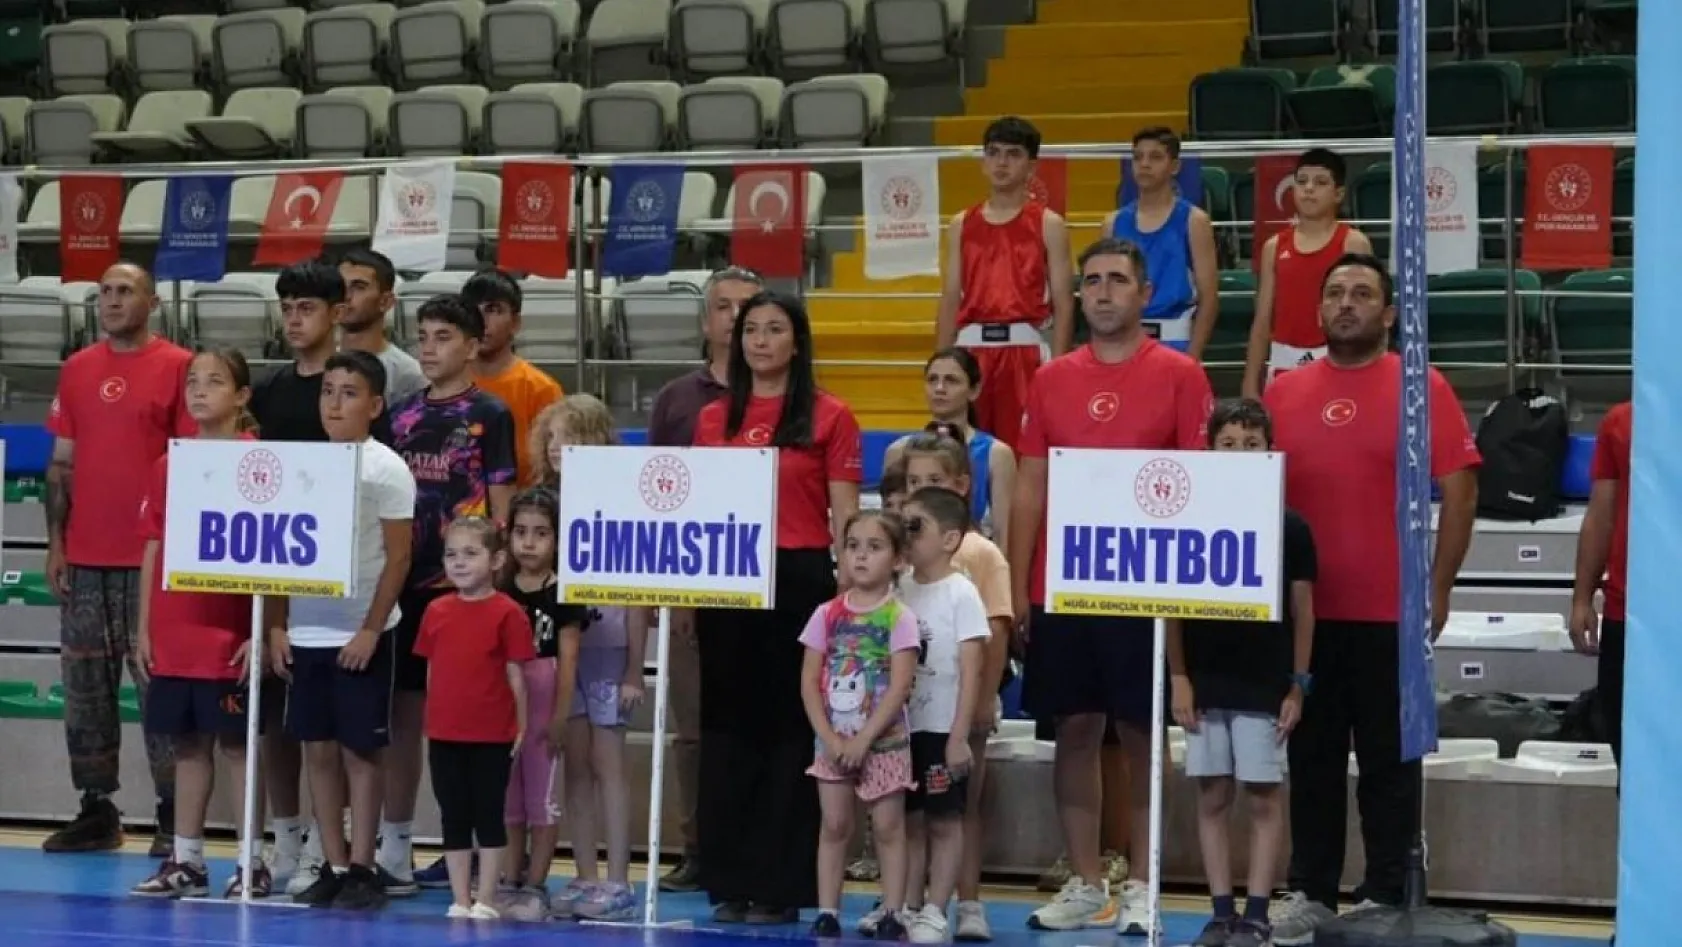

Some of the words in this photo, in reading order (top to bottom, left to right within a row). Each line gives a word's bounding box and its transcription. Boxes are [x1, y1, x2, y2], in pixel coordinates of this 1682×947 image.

[198, 510, 318, 567] BOKS
[567, 509, 762, 577] CİMNASTİK
[1062, 525, 1263, 587] HENTBOL
[1063, 597, 1096, 609] MUĞLA
[1099, 600, 1139, 612] GENÇLİK
[1141, 602, 1154, 612] VE
[1155, 603, 1180, 614] SPOR
[1183, 604, 1192, 615] İL
[1195, 605, 1258, 618] MÜDÜRLÜĞÜ
